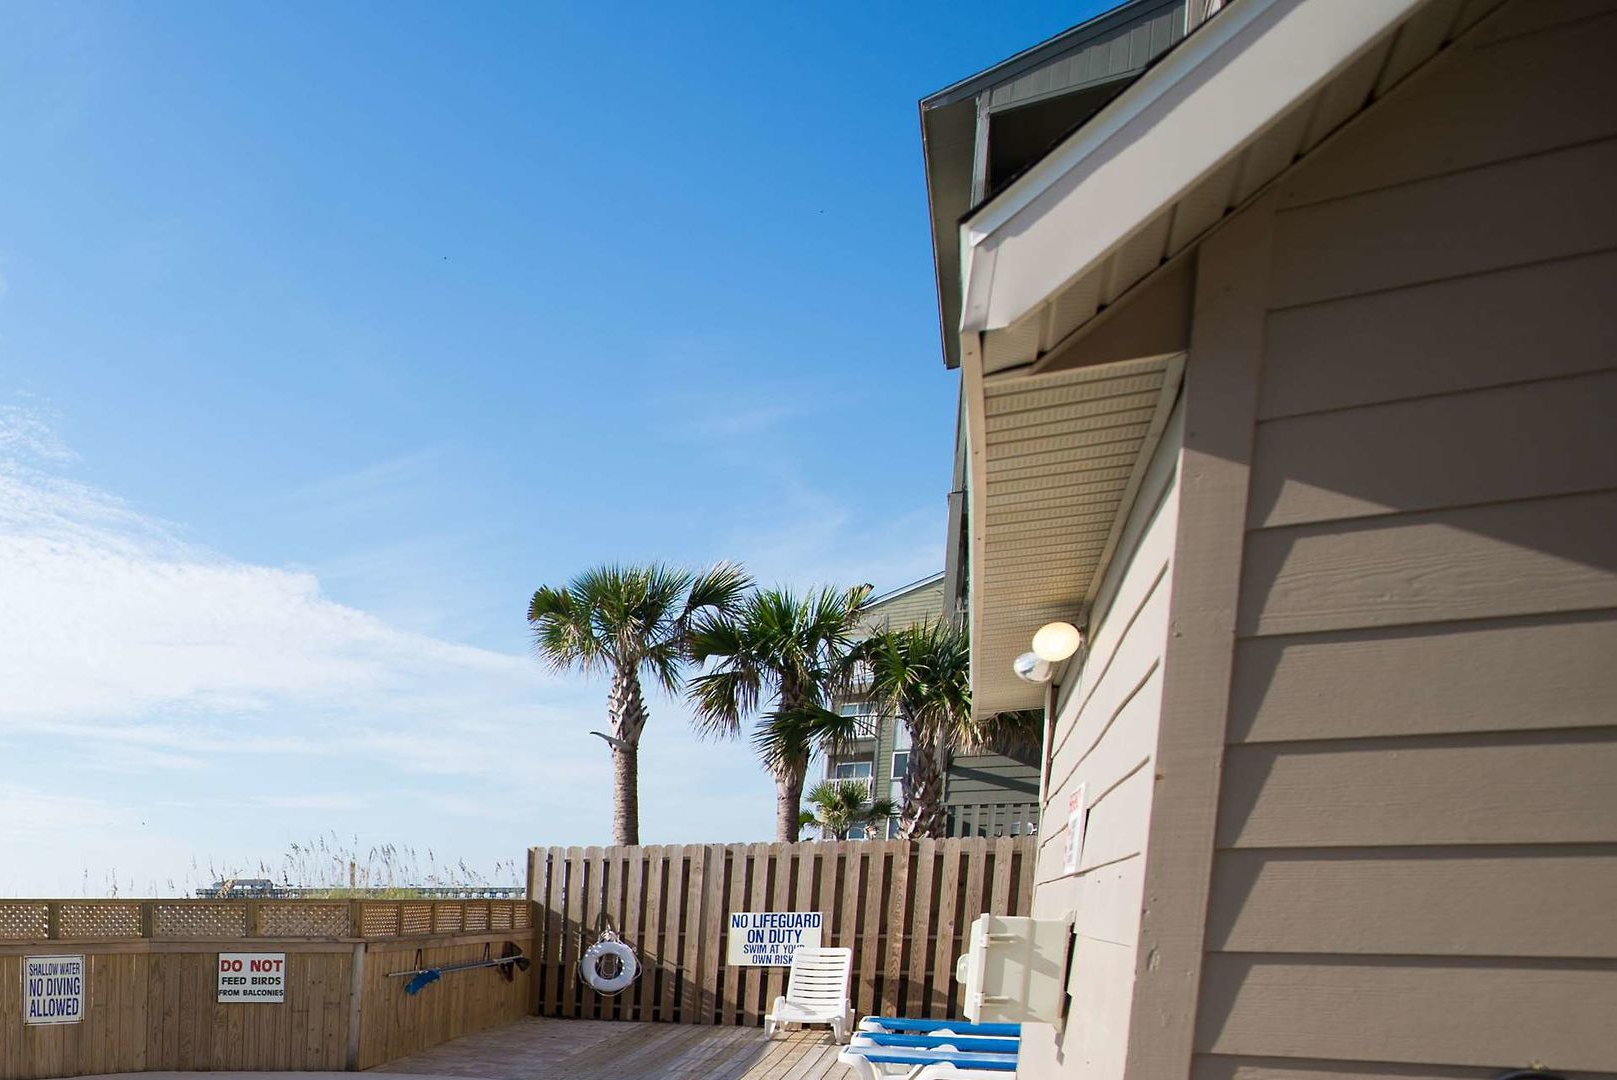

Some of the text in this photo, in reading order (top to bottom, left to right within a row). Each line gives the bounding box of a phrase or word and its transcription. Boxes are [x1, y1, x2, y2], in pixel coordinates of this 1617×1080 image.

[732, 914, 821, 928] NO LIFEGUARD
[748, 929, 802, 943] ON DUTY
[743, 944, 805, 954] SWIM AT YO
[752, 954, 793, 964] OWN RISK
[29, 963, 80, 976] SHALLOW WATER
[221, 960, 283, 972] DO NOT
[30, 977, 80, 996] NO DIVING
[222, 977, 281, 985] FEED BIRDS
[30, 998, 79, 1017] ALLOWED
